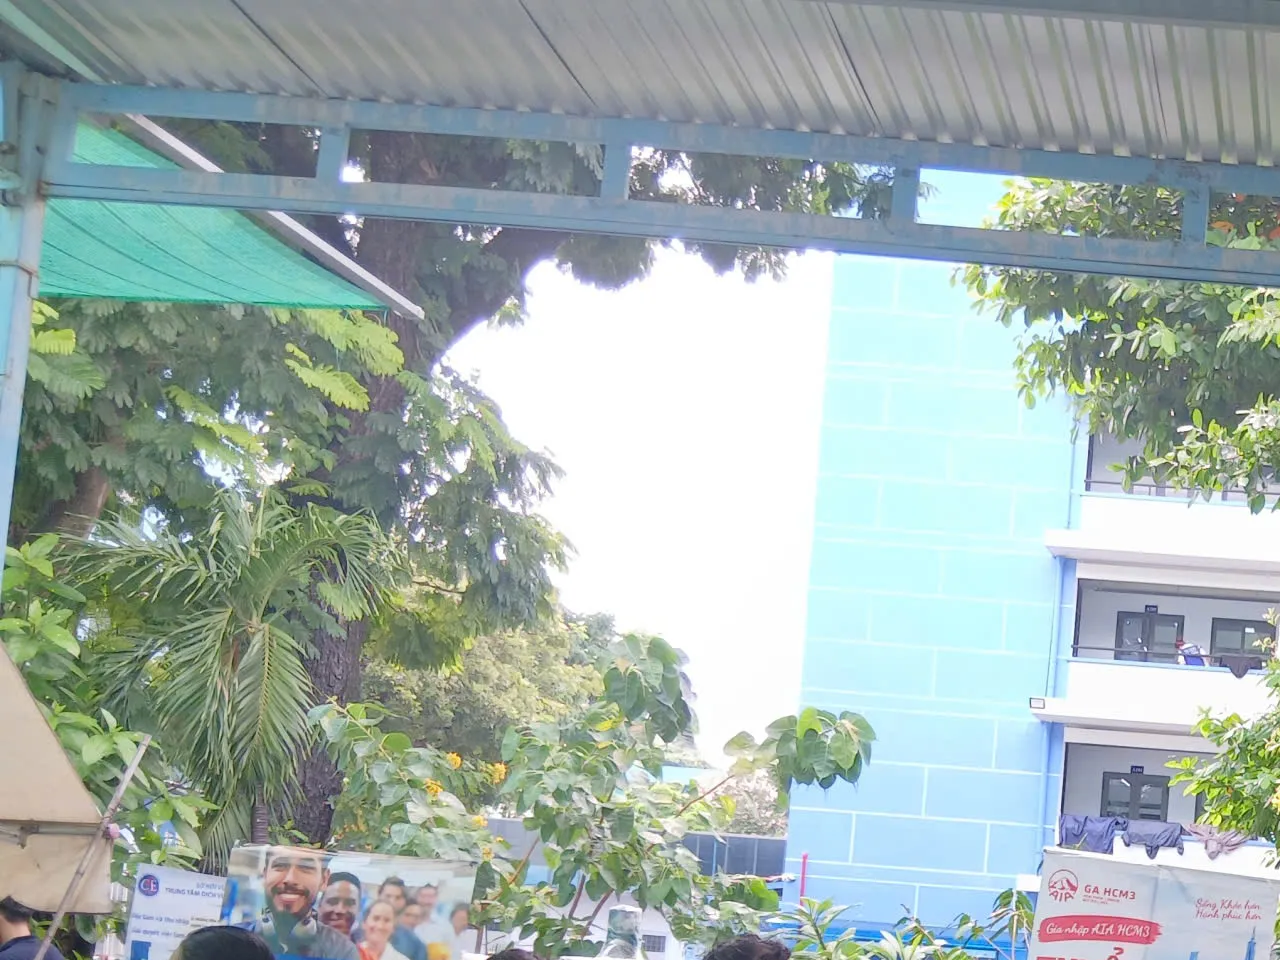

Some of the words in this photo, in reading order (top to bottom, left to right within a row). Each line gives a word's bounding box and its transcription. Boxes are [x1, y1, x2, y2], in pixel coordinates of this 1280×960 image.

[1049, 890, 1075, 902] AIA
[1084, 884, 1100, 895] GA
[1103, 887, 1136, 900] HCM3
[1046, 923, 1064, 935] Gia
[1064, 924, 1089, 937] nhập
[1091, 923, 1115, 936] AIA
[1116, 923, 1151, 938] HCM3
